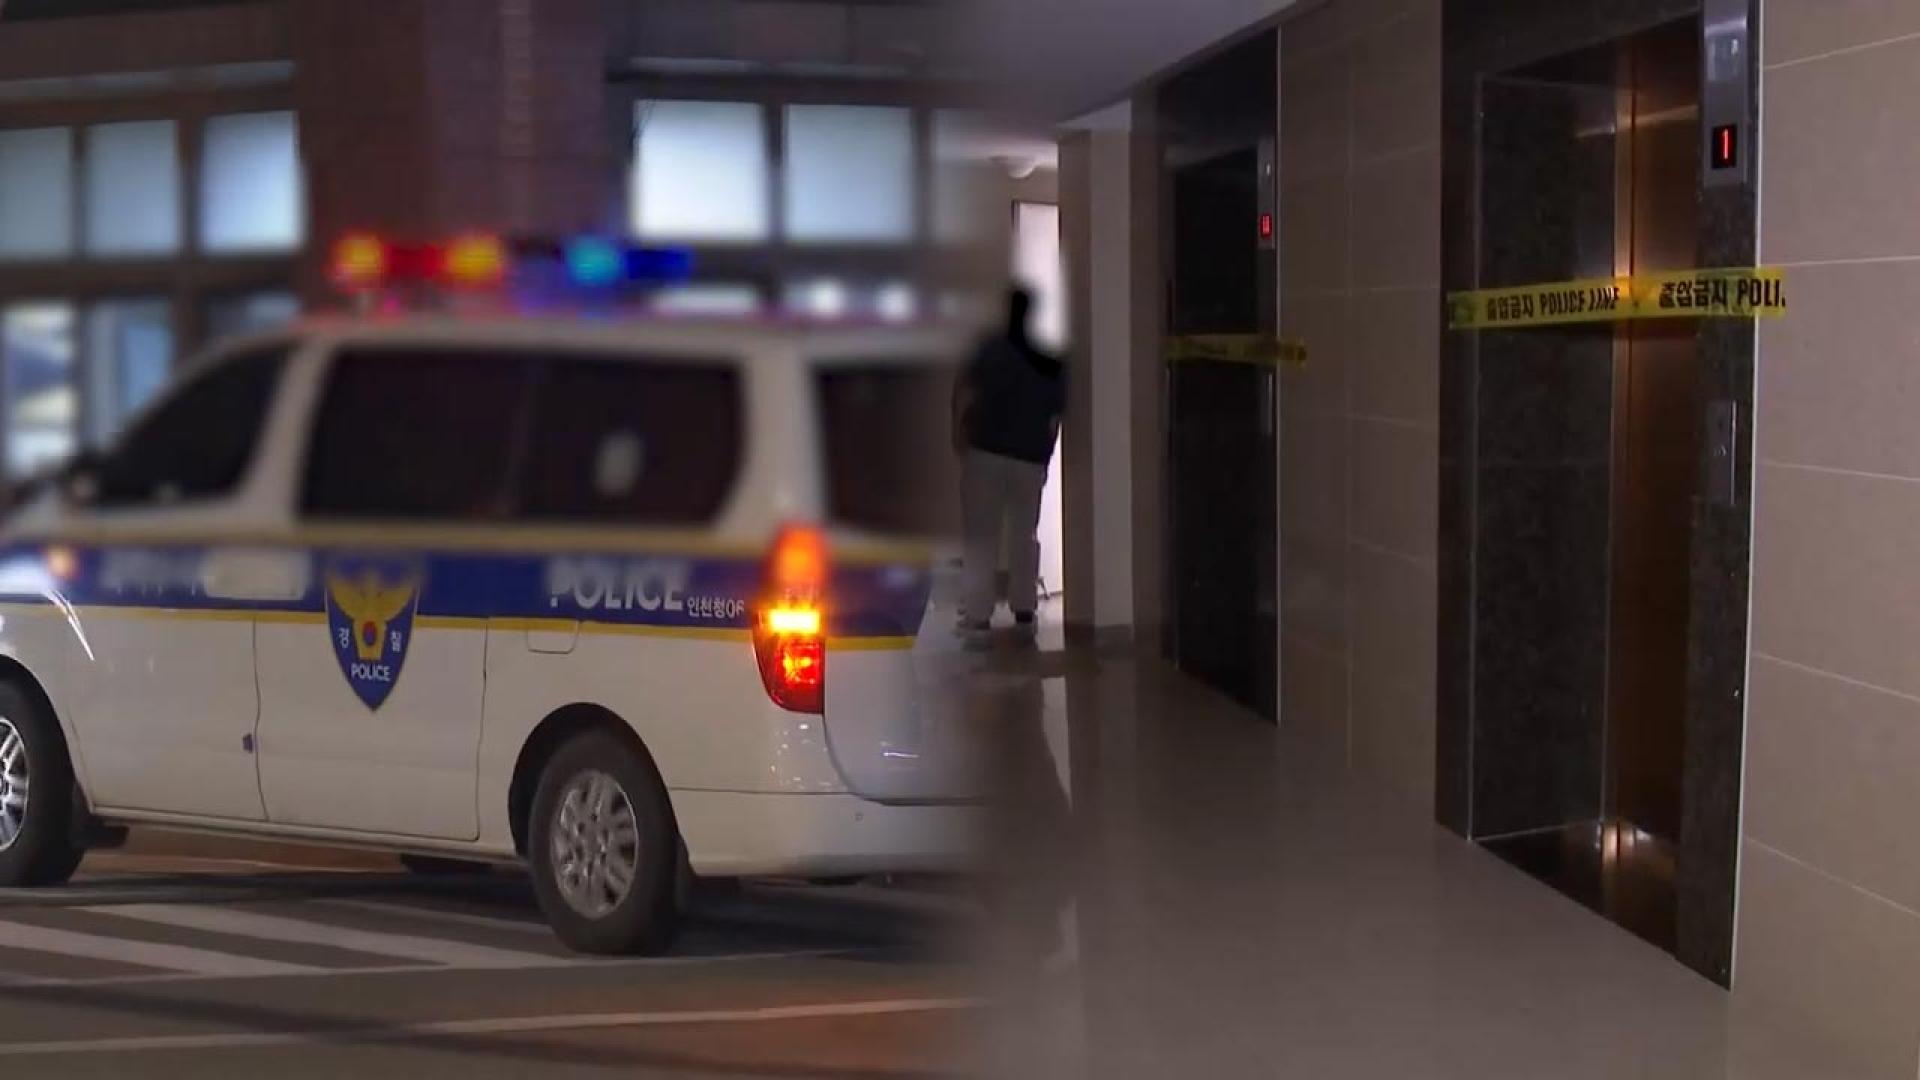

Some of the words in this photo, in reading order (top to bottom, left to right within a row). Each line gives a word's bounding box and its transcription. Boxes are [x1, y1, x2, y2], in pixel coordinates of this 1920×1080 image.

[1539, 289, 1585, 316] POLICE
[1659, 278, 1728, 309] 출입금지
[1737, 278, 1786, 308] POLI
[548, 558, 684, 611] POLICE
[351, 663, 391, 682] POLICE
